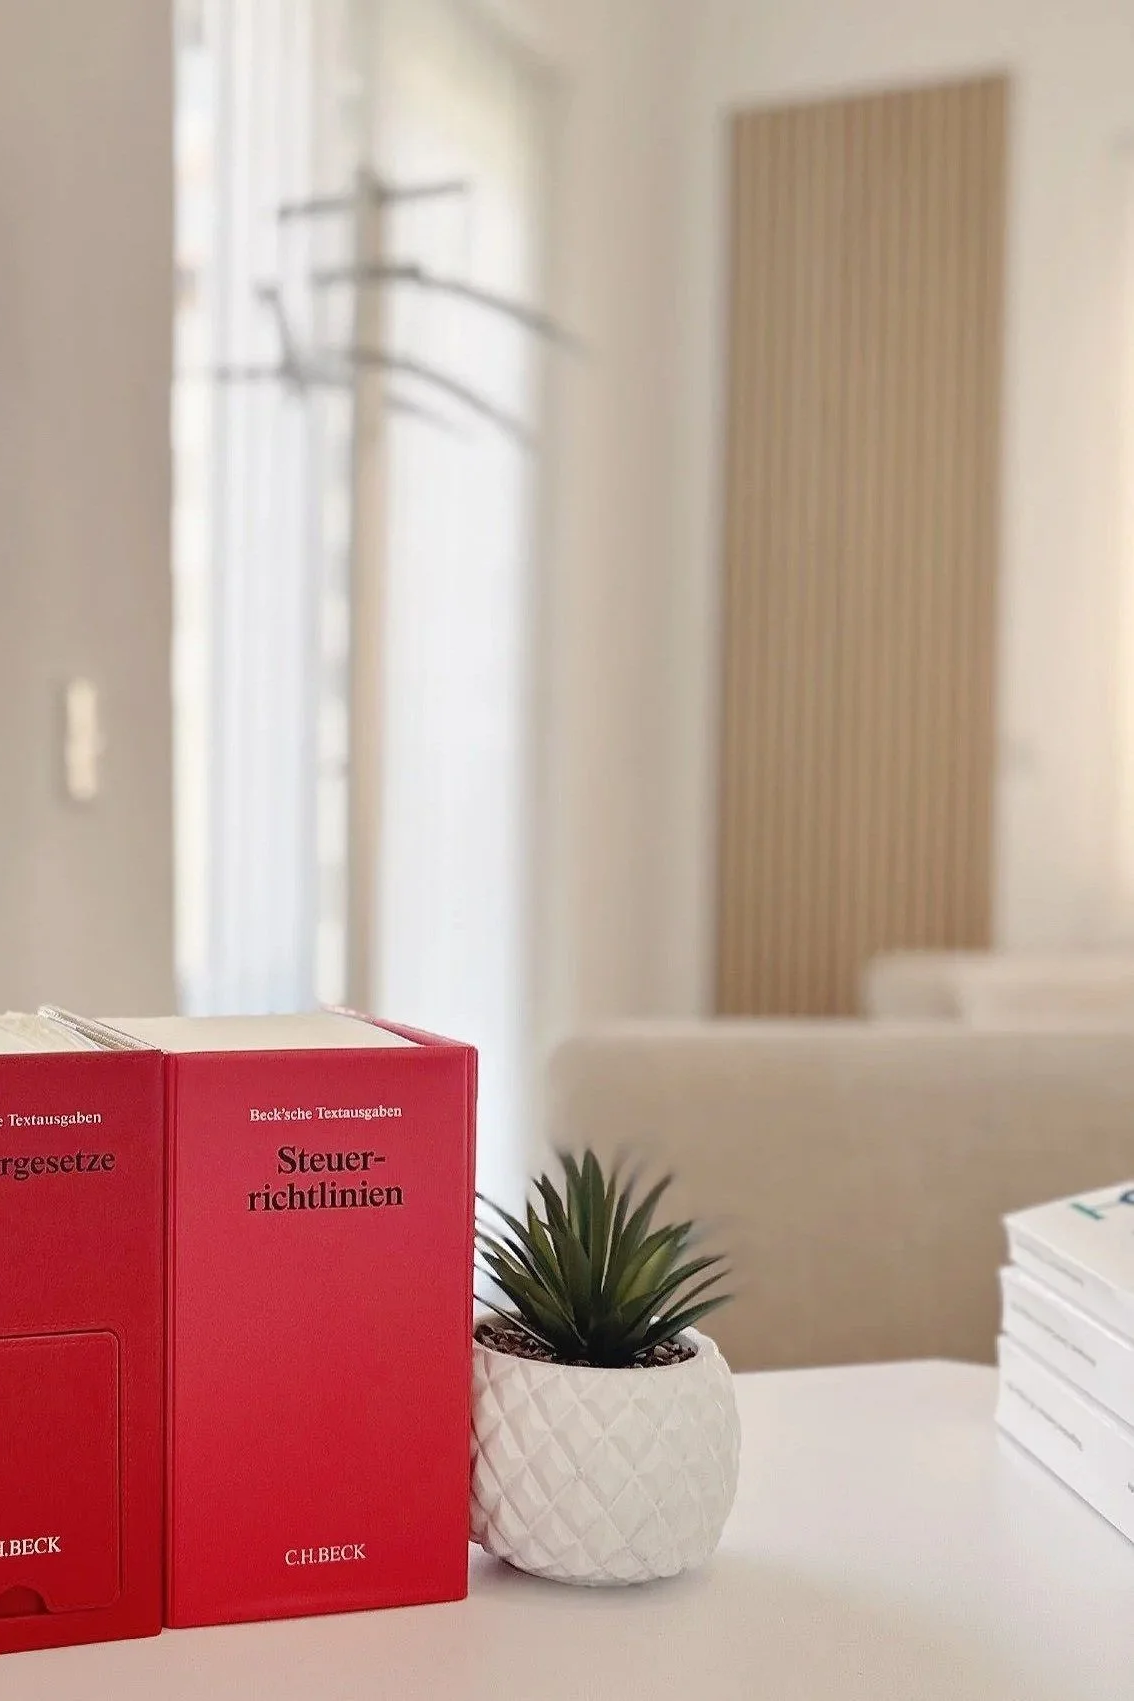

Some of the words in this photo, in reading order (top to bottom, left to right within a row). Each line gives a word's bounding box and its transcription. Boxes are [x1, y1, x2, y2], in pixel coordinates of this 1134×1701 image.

[7, 1110, 102, 1129] Textausgaben
[317, 1105, 402, 1120] Textausgaben
[278, 1146, 386, 1174] Steuer-
[248, 1181, 403, 1211] richtlinien
[284, 1543, 366, 1566] C.H.BECK
